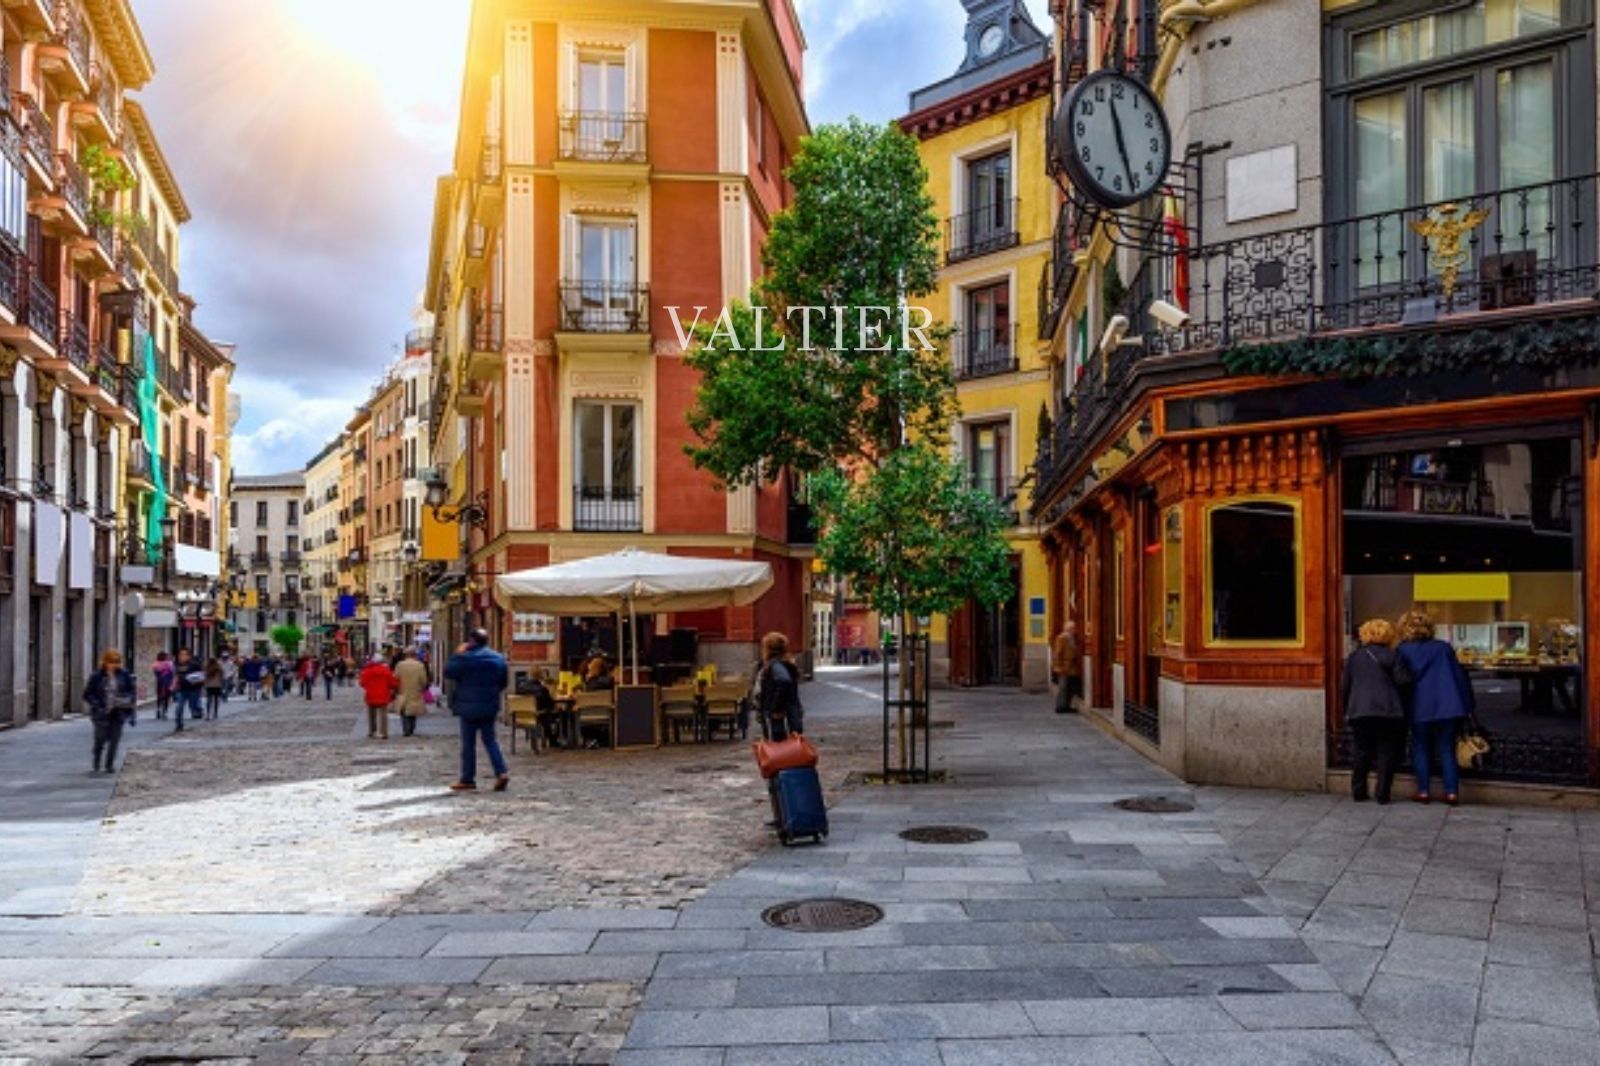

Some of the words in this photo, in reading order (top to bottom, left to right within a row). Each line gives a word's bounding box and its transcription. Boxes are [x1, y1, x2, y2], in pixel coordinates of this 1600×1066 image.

[1111, 83, 1125, 100] 12
[1081, 100, 1094, 115] 10
[1144, 112, 1154, 128] 2
[1150, 138, 1158, 153] 3
[1096, 166, 1104, 181] 7
[1144, 161, 1153, 175] 4
